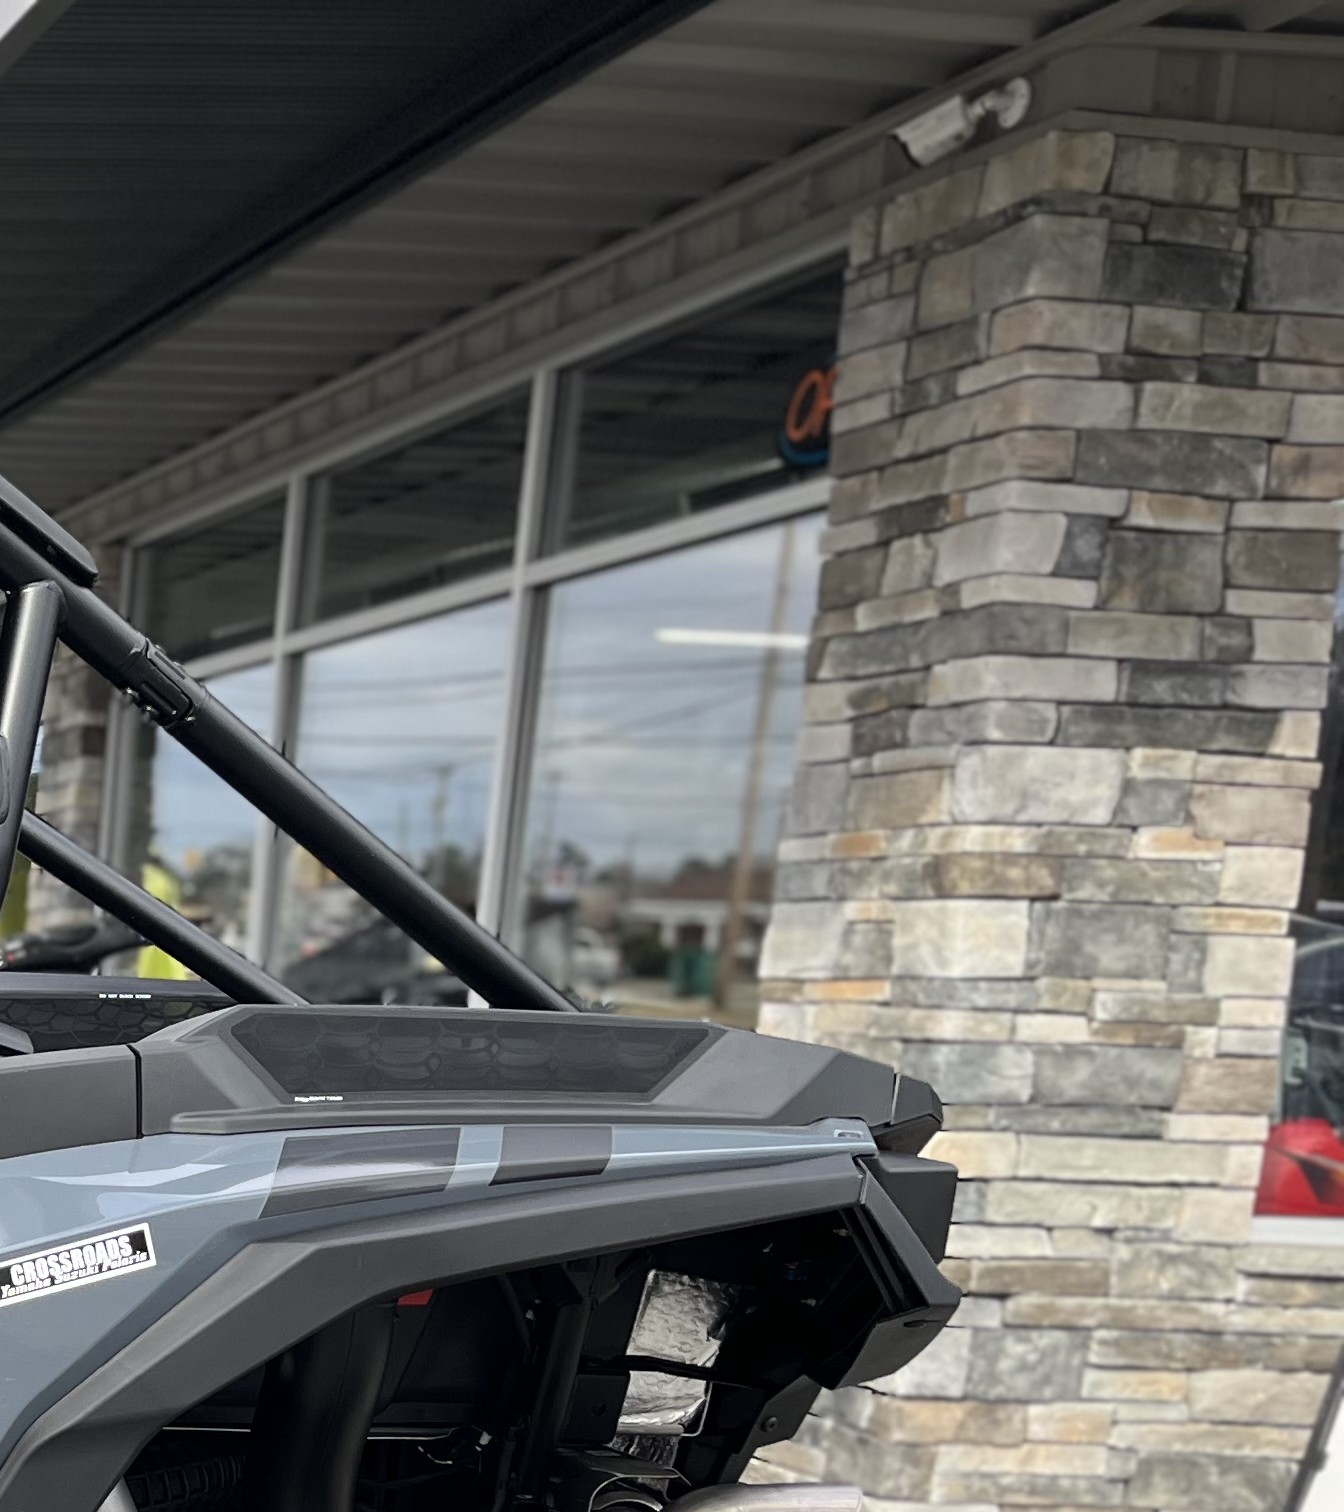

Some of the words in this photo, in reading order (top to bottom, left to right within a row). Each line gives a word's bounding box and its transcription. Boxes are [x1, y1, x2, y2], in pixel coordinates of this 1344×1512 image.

[0, 1277, 52, 1299] Yamaha
[54, 1262, 100, 1285] Suzuki
[102, 1250, 148, 1273] Polaris
[10, 1235, 133, 1286] CROSSROADS
